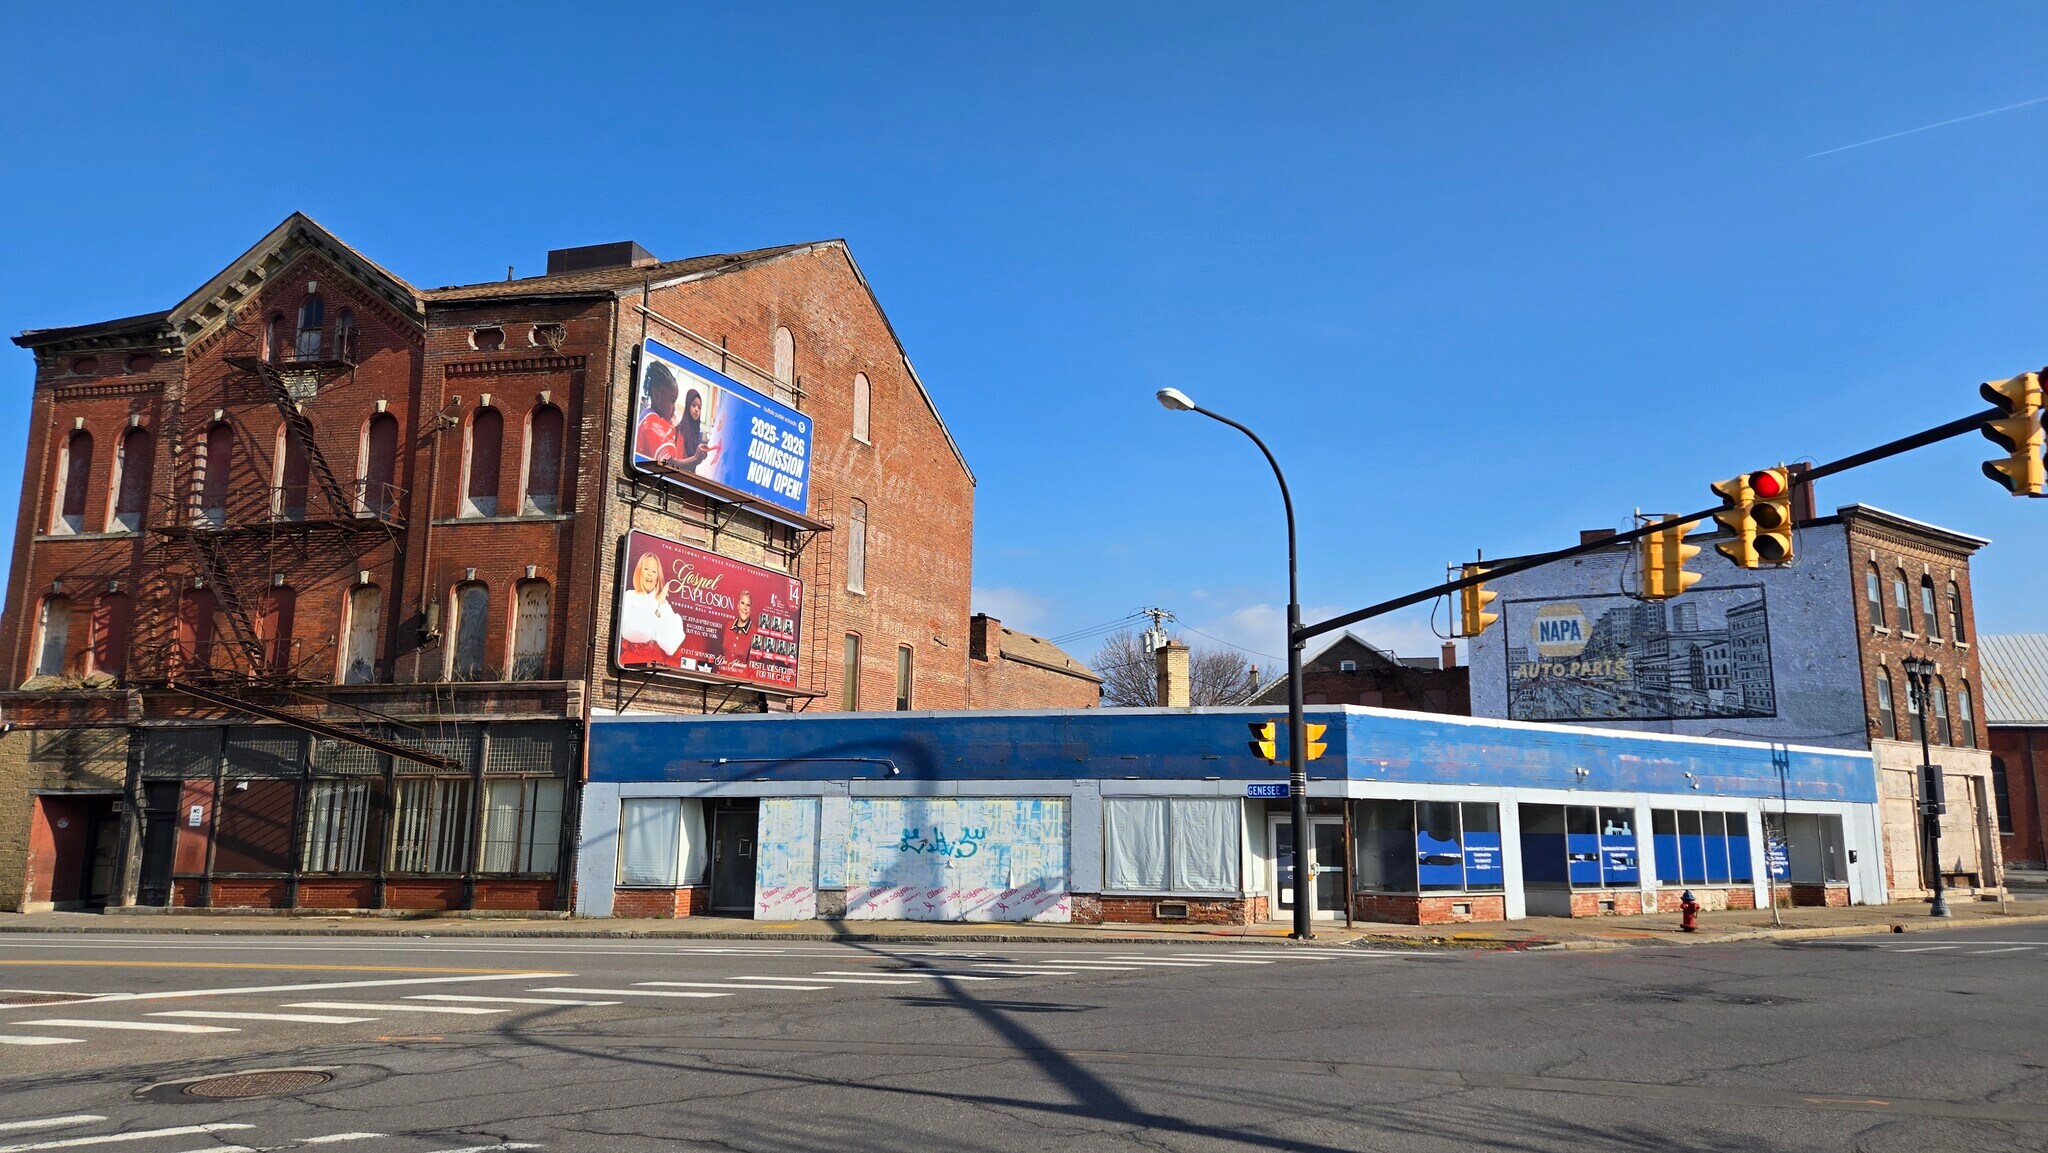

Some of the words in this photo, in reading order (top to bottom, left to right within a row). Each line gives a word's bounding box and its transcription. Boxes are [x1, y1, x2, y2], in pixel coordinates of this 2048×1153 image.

[751, 416, 779, 444] 2025-
[781, 431, 805, 457] 2026
[748, 438, 805, 478] ADMISSION
[747, 461, 774, 489] NOW
[773, 472, 803, 501] OPEN!
[675, 547, 700, 559] NATIONAL
[668, 559, 723, 593] Gospel
[681, 585, 735, 610] EXPLOSION
[789, 584, 800, 605] 14
[1540, 619, 1582, 642] NAPA
[681, 647, 694, 656] EVENT
[1517, 662, 1566, 679] AUTO
[1569, 657, 1630, 681] PARTS
[1248, 786, 1281, 796] GENESEE
